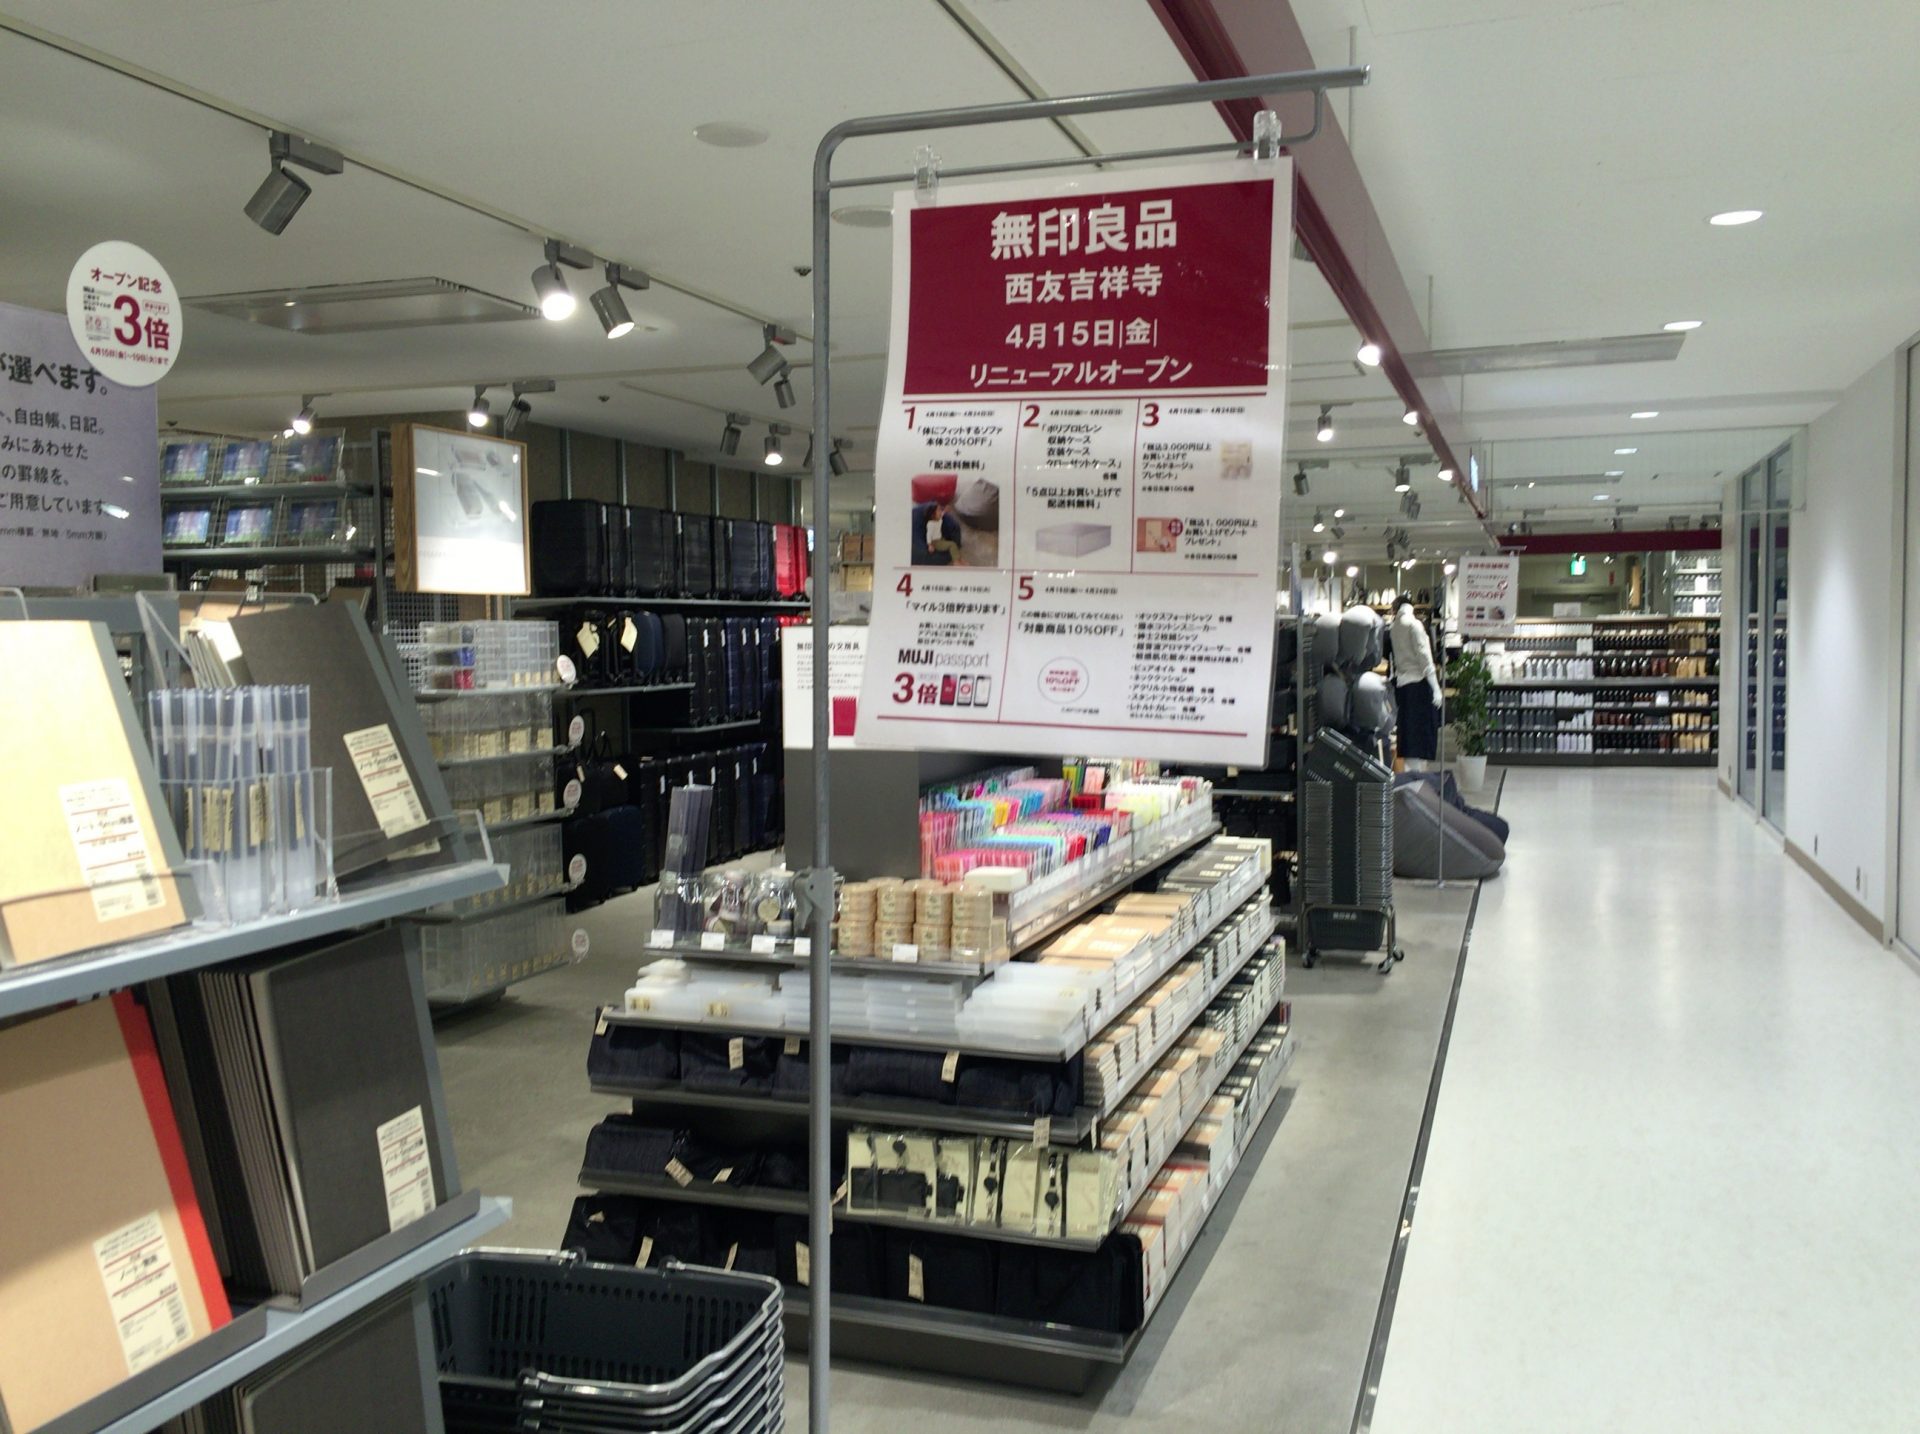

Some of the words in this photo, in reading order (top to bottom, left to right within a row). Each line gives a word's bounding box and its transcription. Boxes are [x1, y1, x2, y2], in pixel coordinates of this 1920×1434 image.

[990, 199, 1178, 261] 無印良品
[91, 267, 162, 294] オープン記念
[1004, 264, 1163, 304] 西友吉祥寺
[114, 295, 170, 351] 3倍
[970, 355, 1194, 388] リニューアルオープン
[904, 406, 916, 430] 1
[1024, 404, 1040, 428] 2
[1142, 402, 1160, 428] 3
[1, 435, 88, 460] みにあわせた
[1048, 436, 1092, 445] 収納ケース
[1142, 452, 1188, 461] お買い上げで
[896, 572, 914, 598] 4
[1018, 576, 1034, 601] 5
[898, 649, 934, 665] MUJI
[934, 652, 990, 668] passport
[892, 671, 939, 704] 3倍
